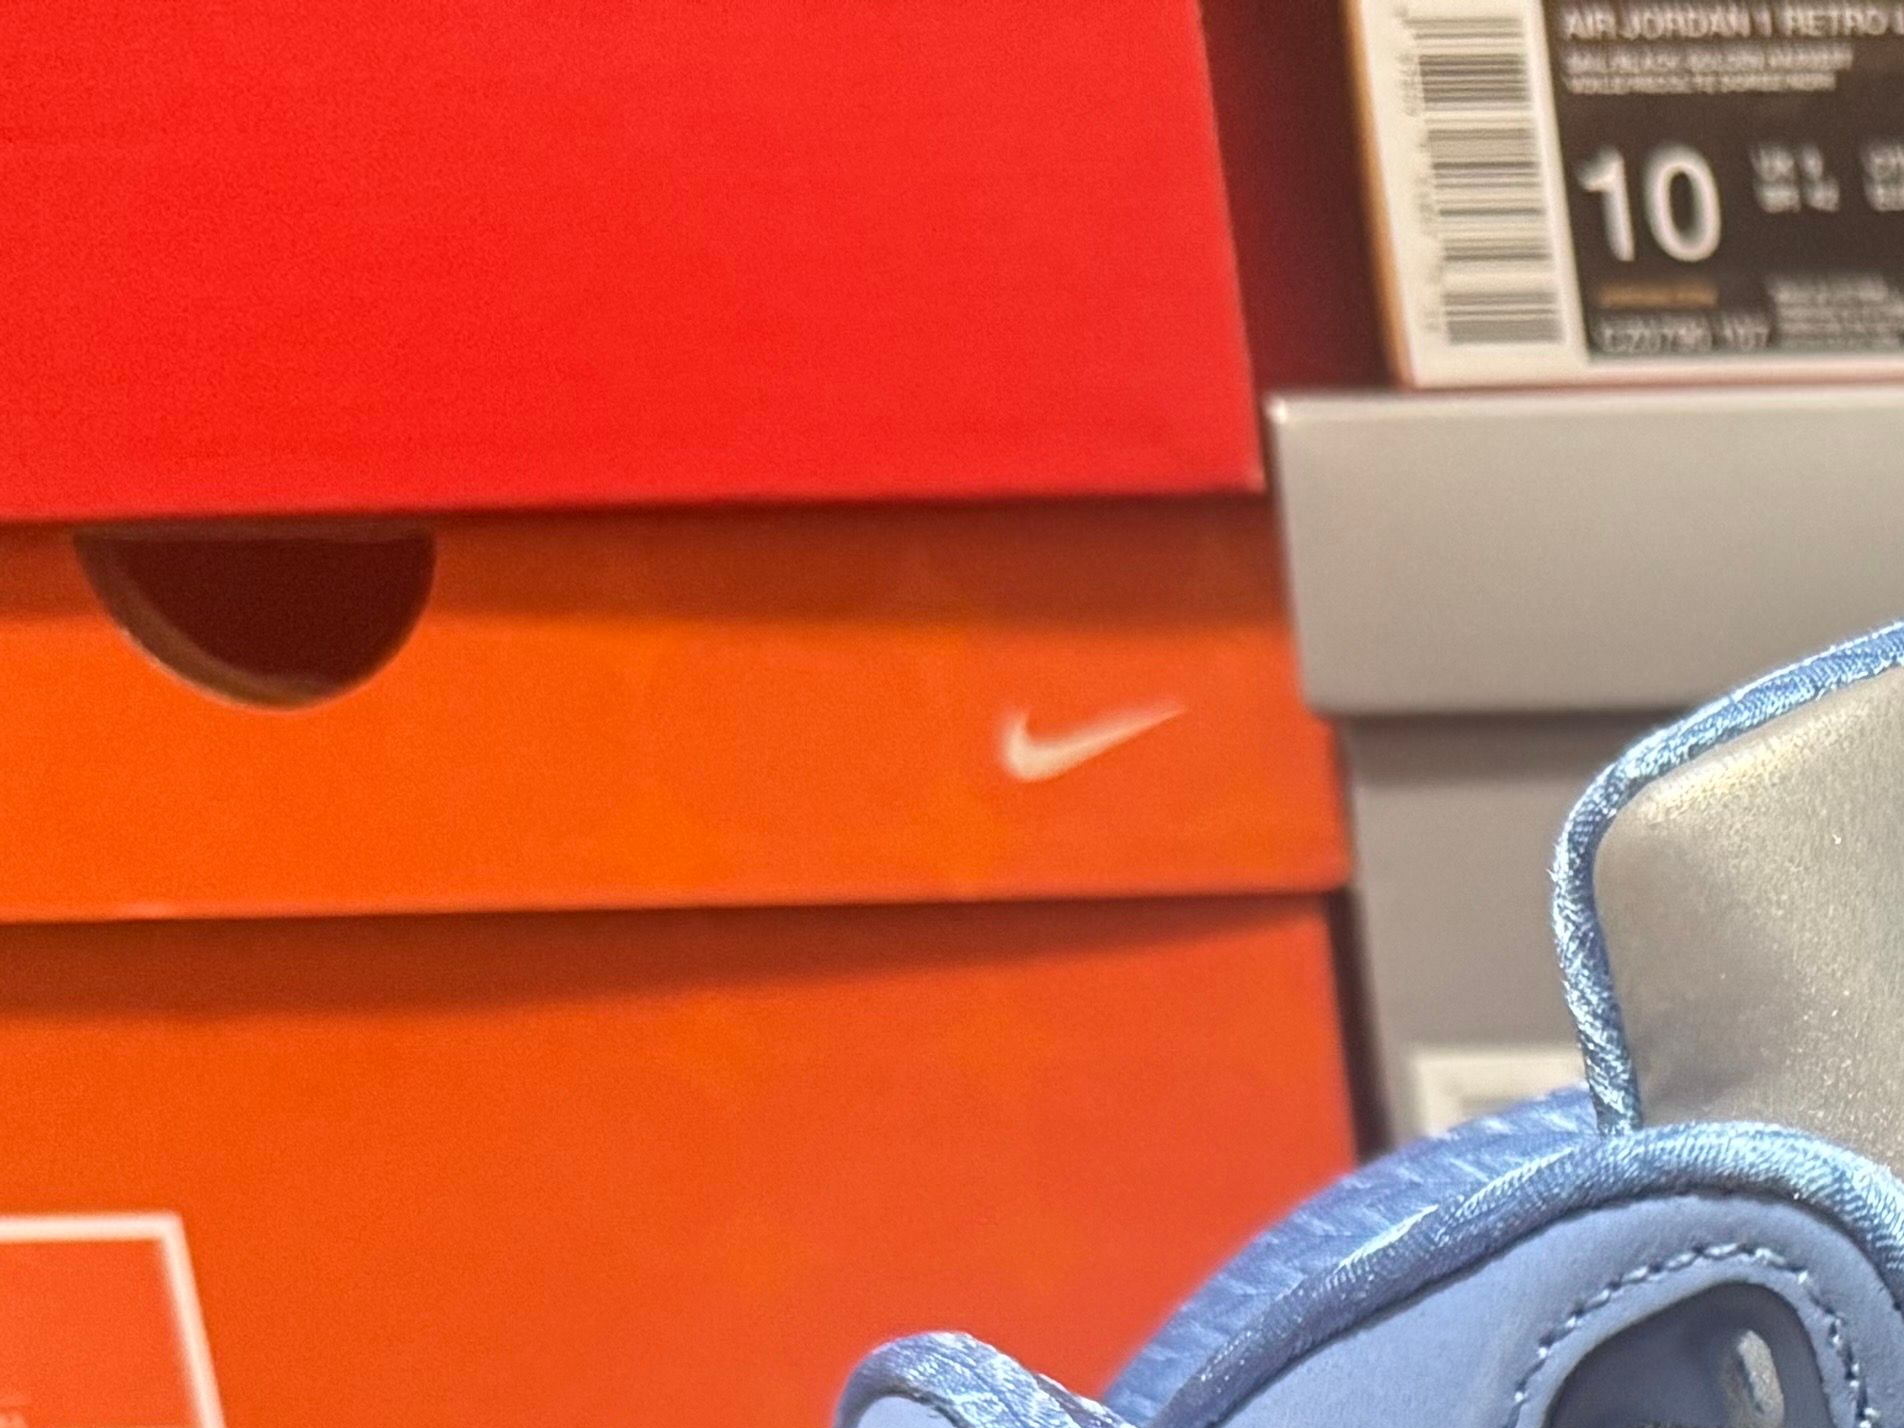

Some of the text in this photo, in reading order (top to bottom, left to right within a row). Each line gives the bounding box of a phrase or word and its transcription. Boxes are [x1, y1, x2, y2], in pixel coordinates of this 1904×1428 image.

[1564, 2, 1617, 40] AIR
[1619, 1, 1750, 40] JORDAN
[1778, 0, 1888, 37] RETRO
[1579, 145, 1721, 262] 10
